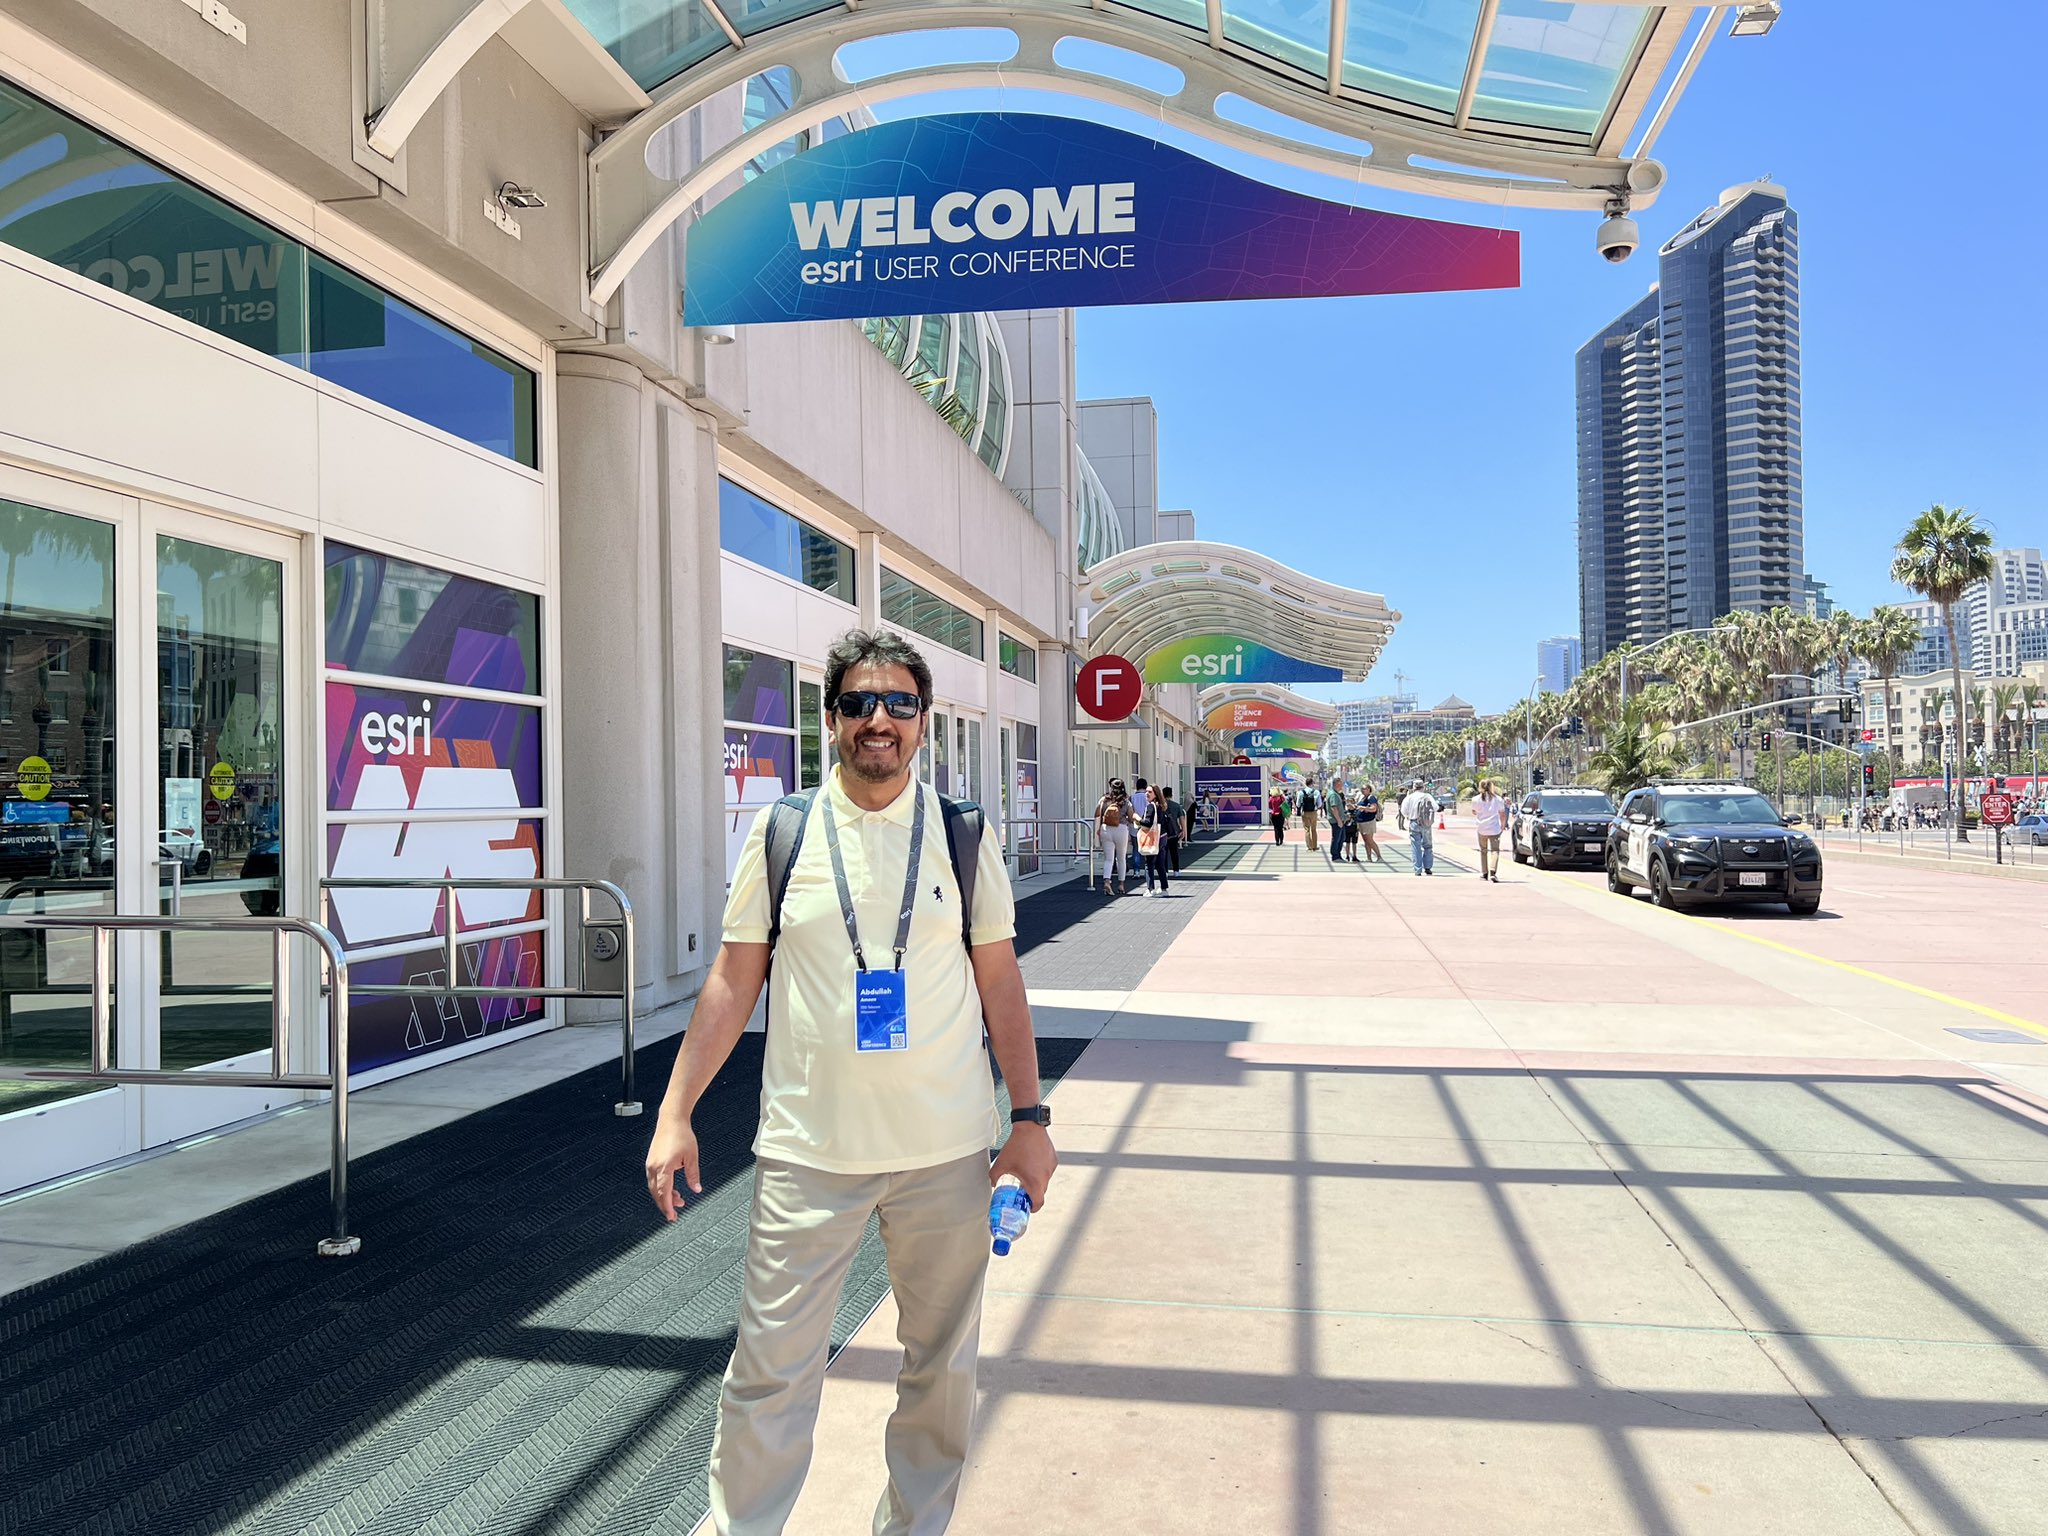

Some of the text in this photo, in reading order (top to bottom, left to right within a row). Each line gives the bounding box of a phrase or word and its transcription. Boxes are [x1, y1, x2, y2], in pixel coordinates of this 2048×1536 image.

[789, 182, 1136, 250] WELCOME
[800, 245, 1136, 285] esri USER CONFERENCE
[1181, 645, 1243, 676] esri
[1095, 668, 1122, 707] F
[361, 699, 432, 756] esri
[1251, 735, 1272, 747] UC
[724, 733, 748, 769] esri
[20, 774, 50, 783] CAUTION
[900, 907, 912, 919] esri
[860, 987, 892, 996] Abdullah
